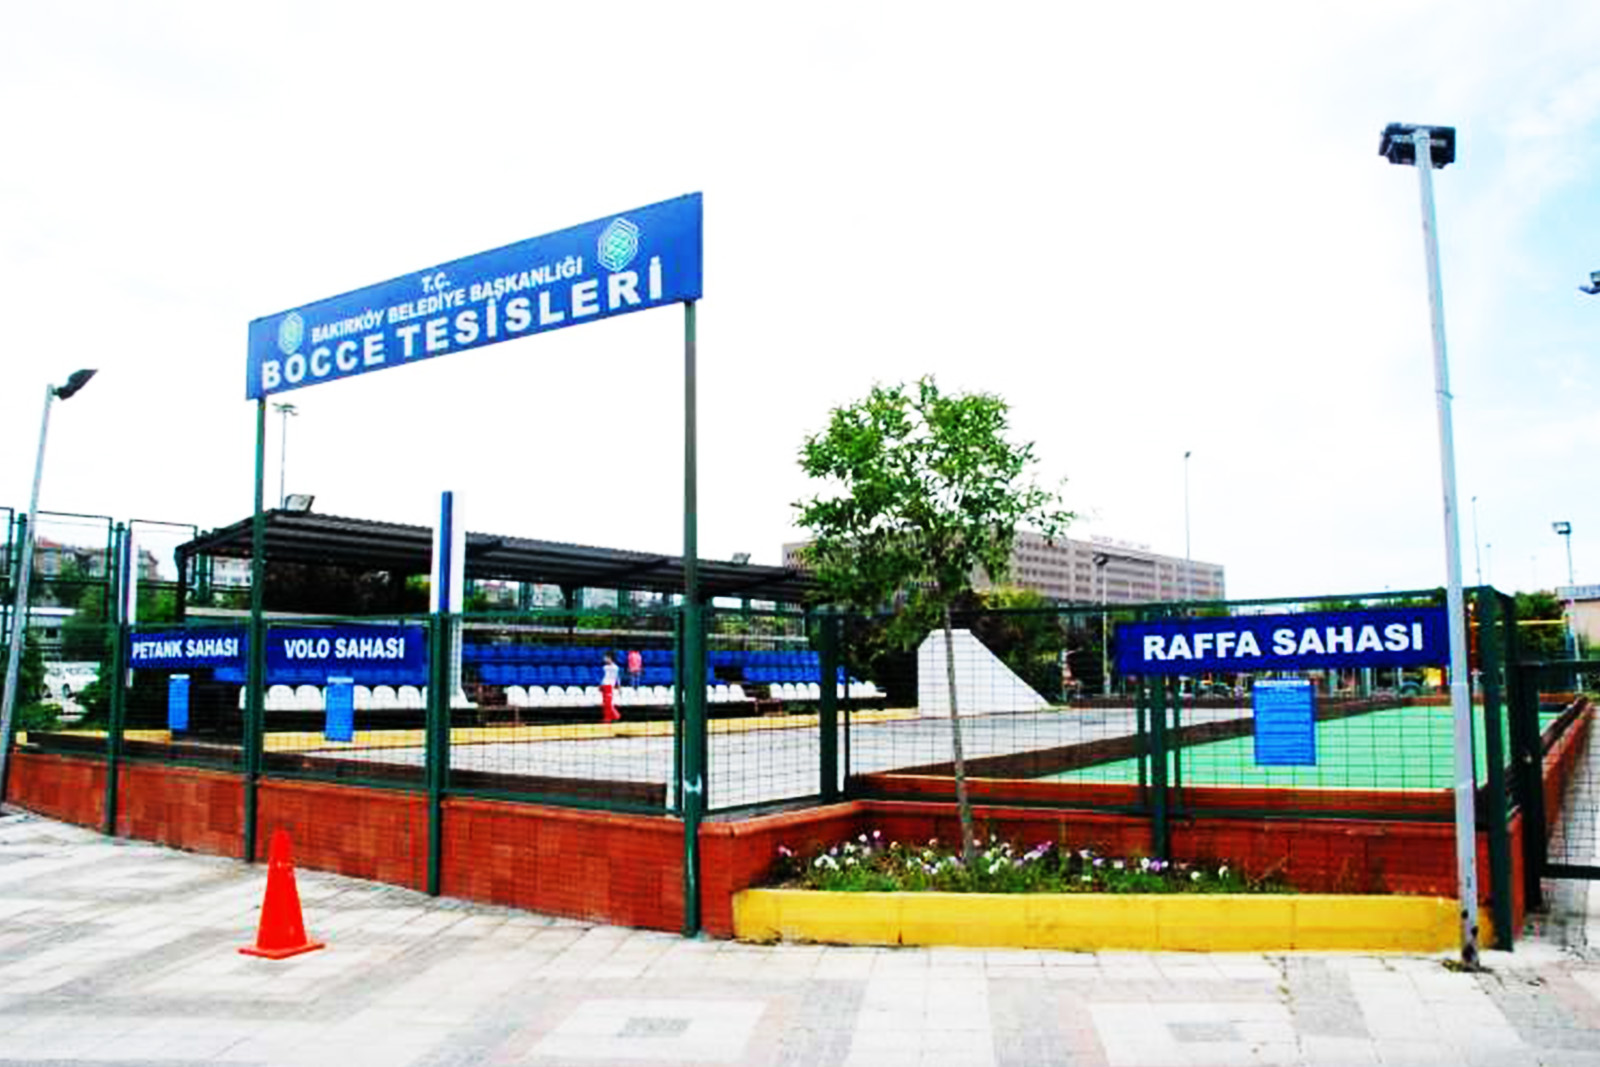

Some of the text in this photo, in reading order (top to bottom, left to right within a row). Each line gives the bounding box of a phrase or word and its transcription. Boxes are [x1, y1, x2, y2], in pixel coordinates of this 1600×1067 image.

[312, 256, 582, 343] BAKIRKÖY BELEDİYE BAŞKANLIĞI
[262, 256, 662, 390] BOCCE TESİSLERİ
[132, 638, 238, 659] PETANK SAHASI
[284, 638, 405, 659] VOLO SAHASI
[1143, 623, 1423, 660] RAFFA SAHASI
